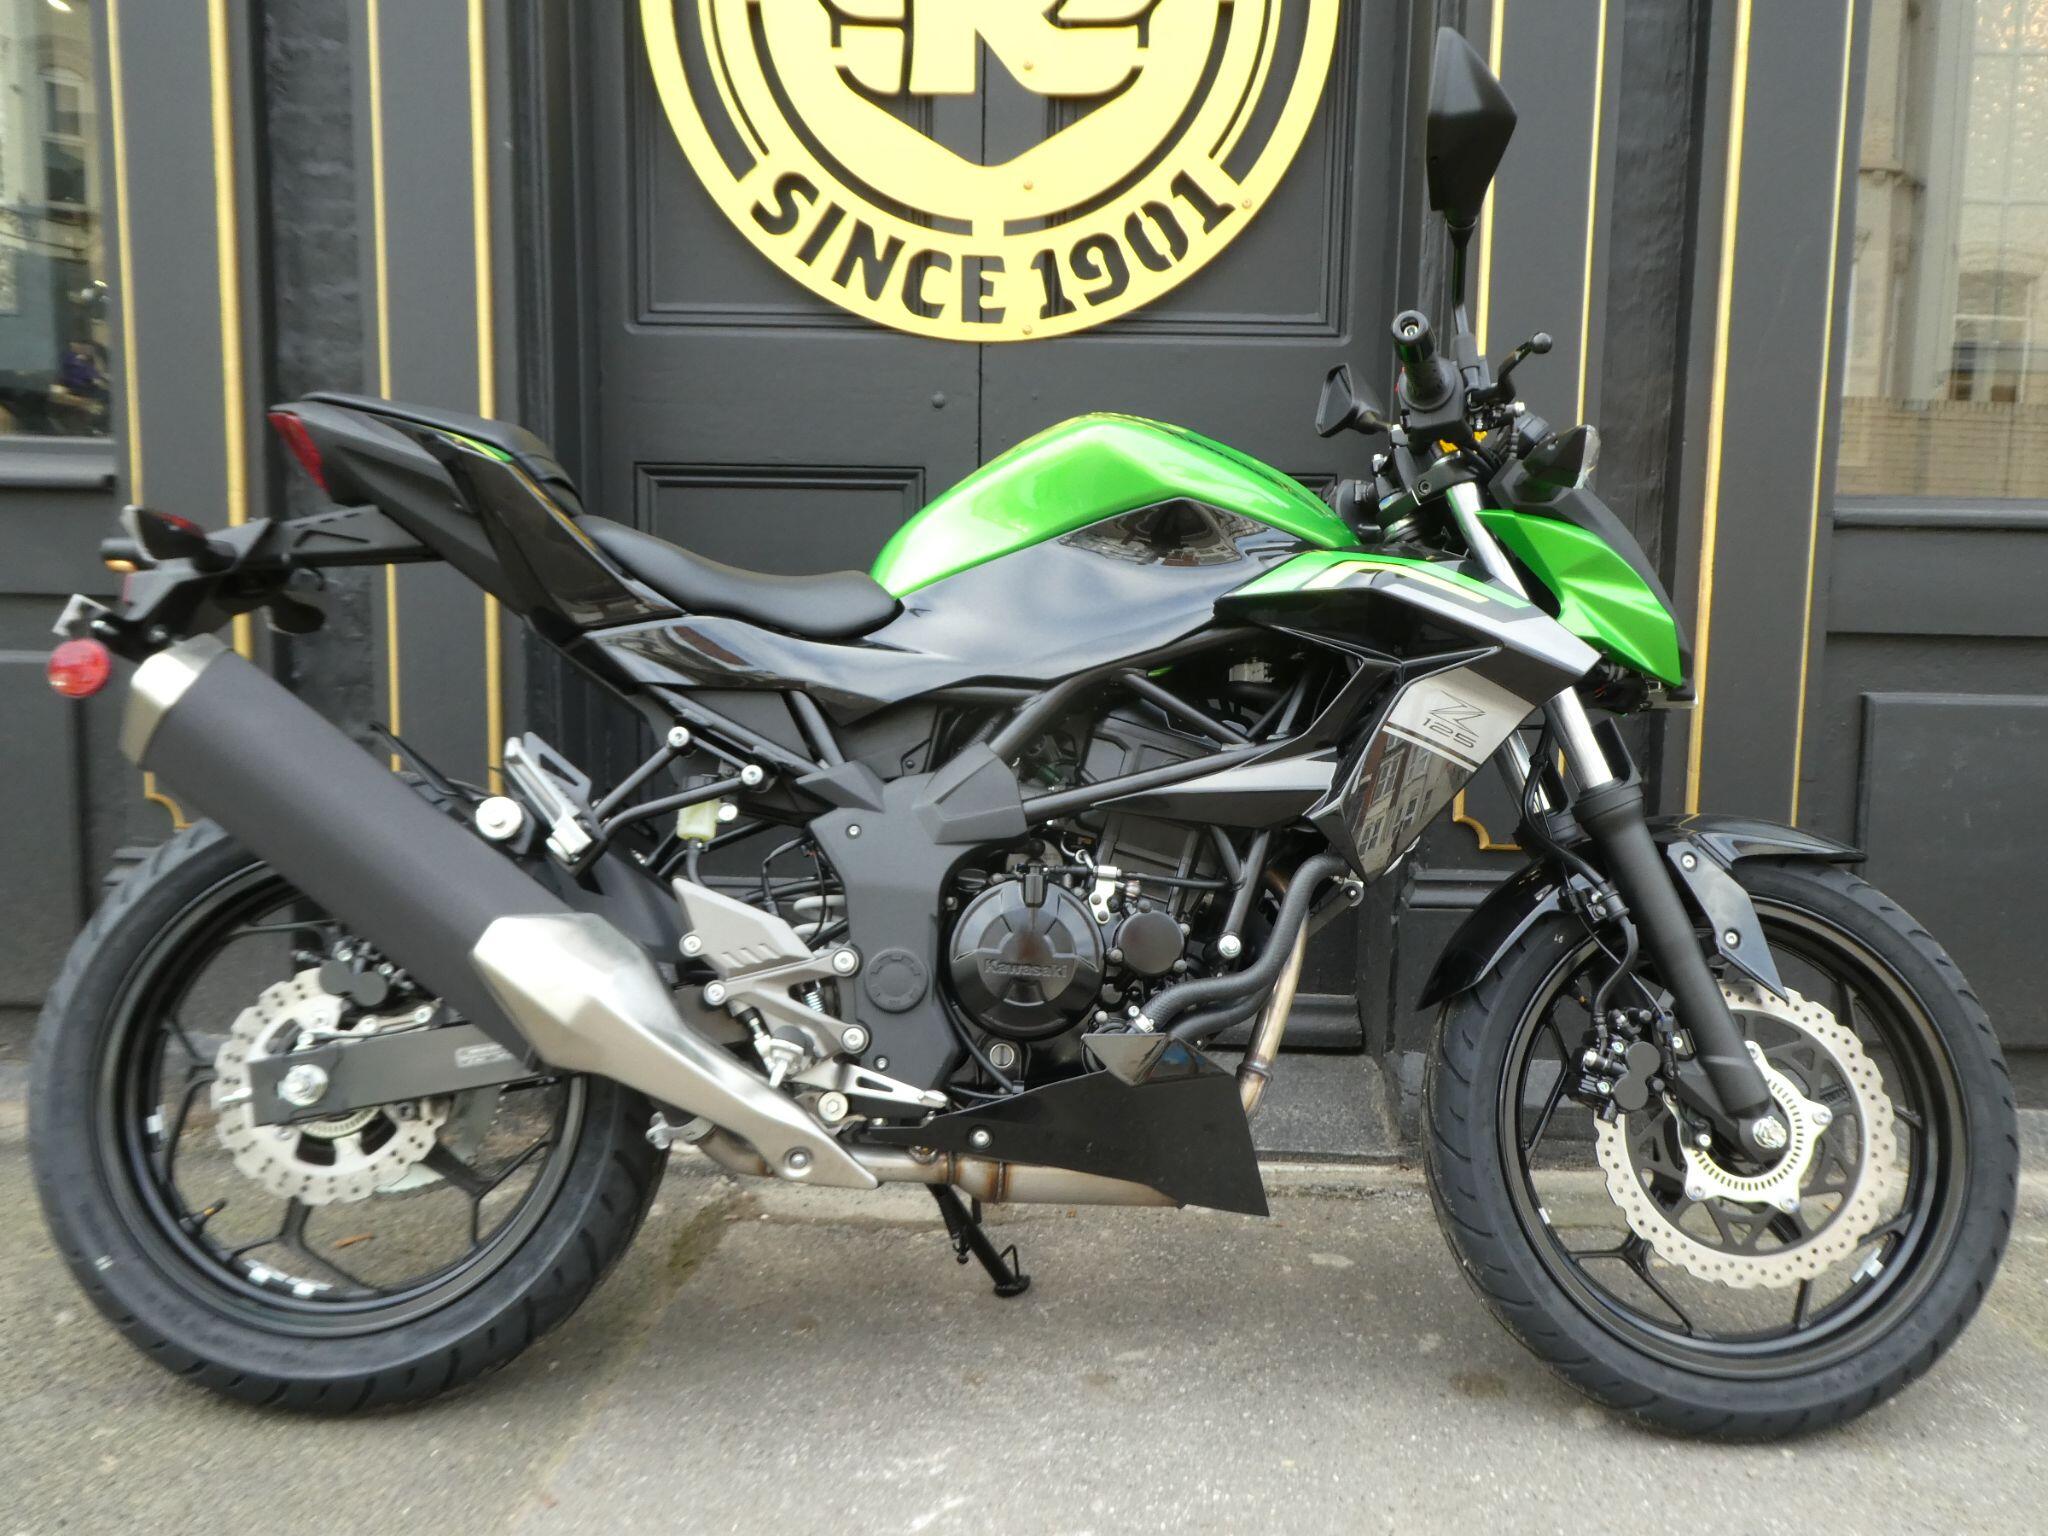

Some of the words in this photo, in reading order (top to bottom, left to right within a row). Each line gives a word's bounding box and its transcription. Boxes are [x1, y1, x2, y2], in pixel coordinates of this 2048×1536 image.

[751, 172, 1006, 324] SINCE
[1031, 169, 1238, 319] 1901
[1422, 717, 1477, 749] 125
[1429, 690, 1486, 738] Z
[984, 959, 1068, 978] Kawasaki
